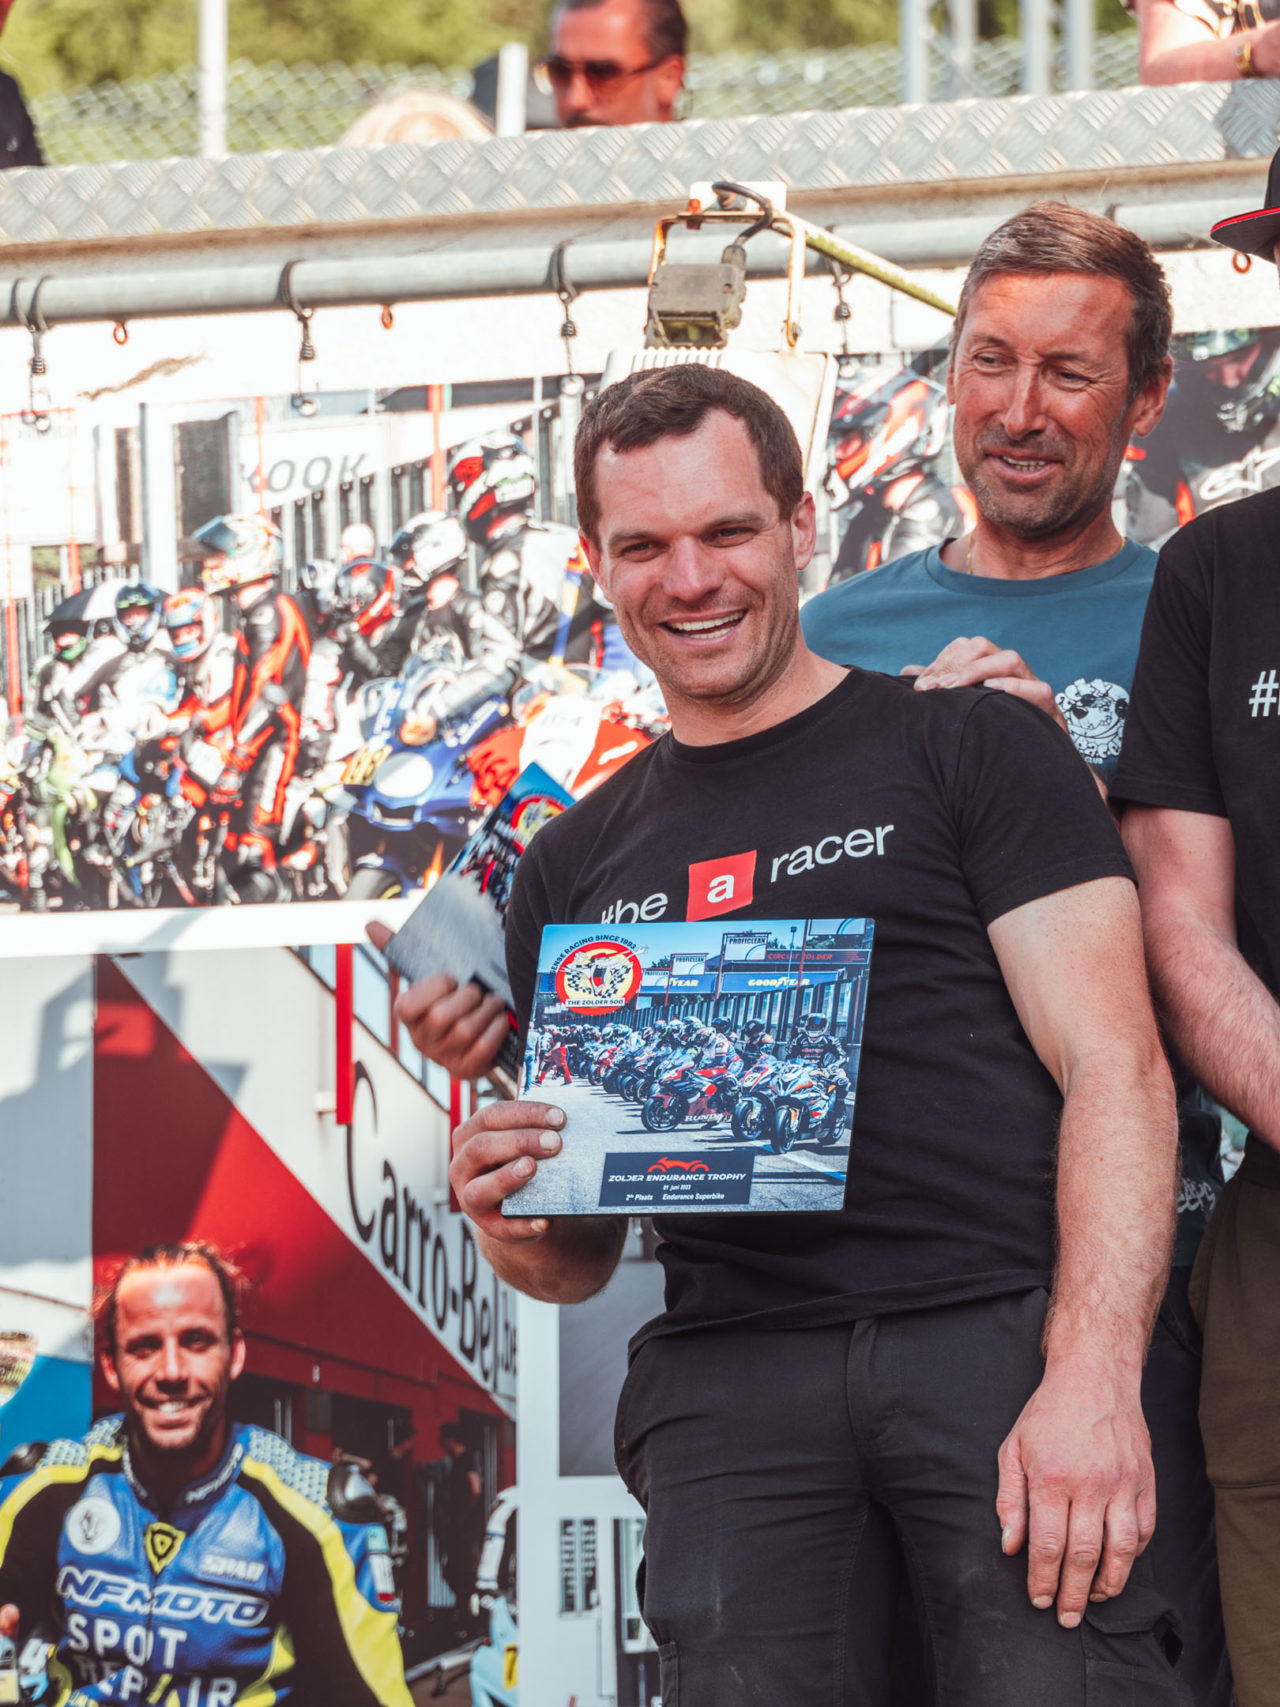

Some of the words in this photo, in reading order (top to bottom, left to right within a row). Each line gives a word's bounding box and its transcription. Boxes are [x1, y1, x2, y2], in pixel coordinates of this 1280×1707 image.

[706, 874, 735, 904] a
[770, 824, 895, 883] racer
[563, 936, 594, 954] RACING
[595, 934, 620, 942] SINCE
[620, 937, 637, 950] 1993
[728, 936, 767, 945] PROFICLEAN
[608, 1174, 645, 1182] ZOLDER
[646, 1173, 705, 1181] ENDURANCE
[708, 1173, 747, 1181] TROPHY
[670, 1184, 680, 1192] juni
[635, 1193, 654, 1201] Plaats
[662, 1193, 694, 1201] Endurance
[695, 1193, 725, 1201] Superbike
[56, 1564, 270, 1628] NFMOTO
[66, 1612, 188, 1669] SPOT
